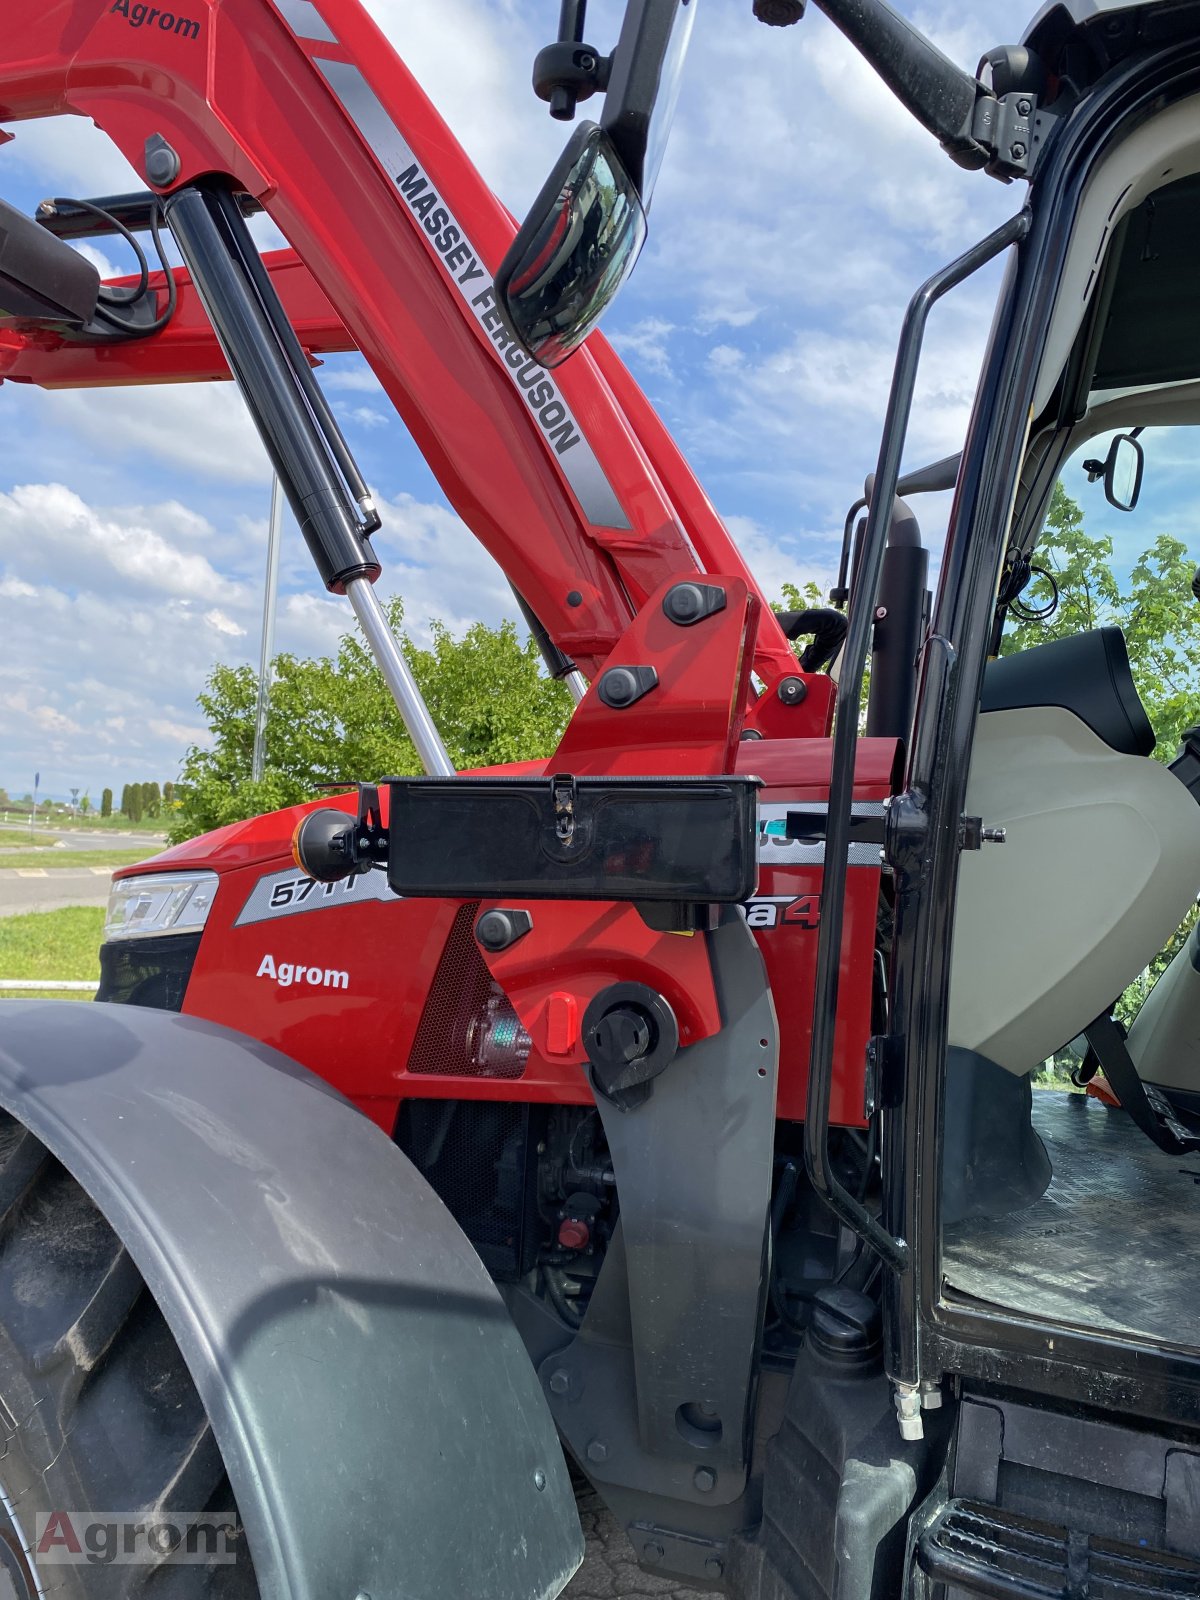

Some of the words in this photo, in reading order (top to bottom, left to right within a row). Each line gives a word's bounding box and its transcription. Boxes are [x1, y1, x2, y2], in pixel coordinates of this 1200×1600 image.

[110, 0, 201, 39] Agrom
[395, 163, 484, 285] MASSEY
[256, 954, 349, 989] Agrom
